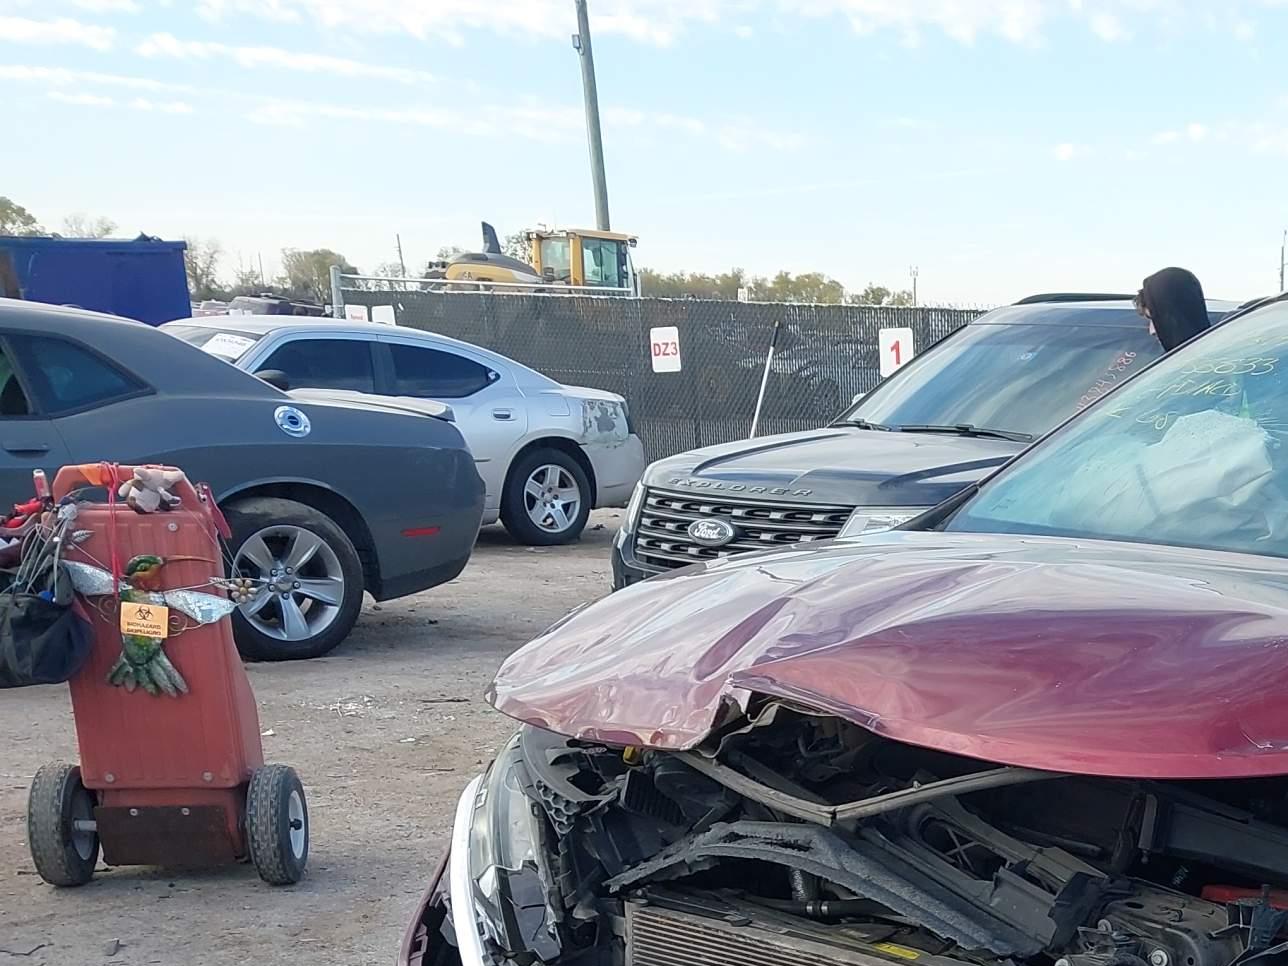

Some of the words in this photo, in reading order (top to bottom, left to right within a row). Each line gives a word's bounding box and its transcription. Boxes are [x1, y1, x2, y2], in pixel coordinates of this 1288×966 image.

[652, 341, 679, 357] DZ3
[890, 340, 901, 365] 1
[668, 478, 814, 497] EXPLORER
